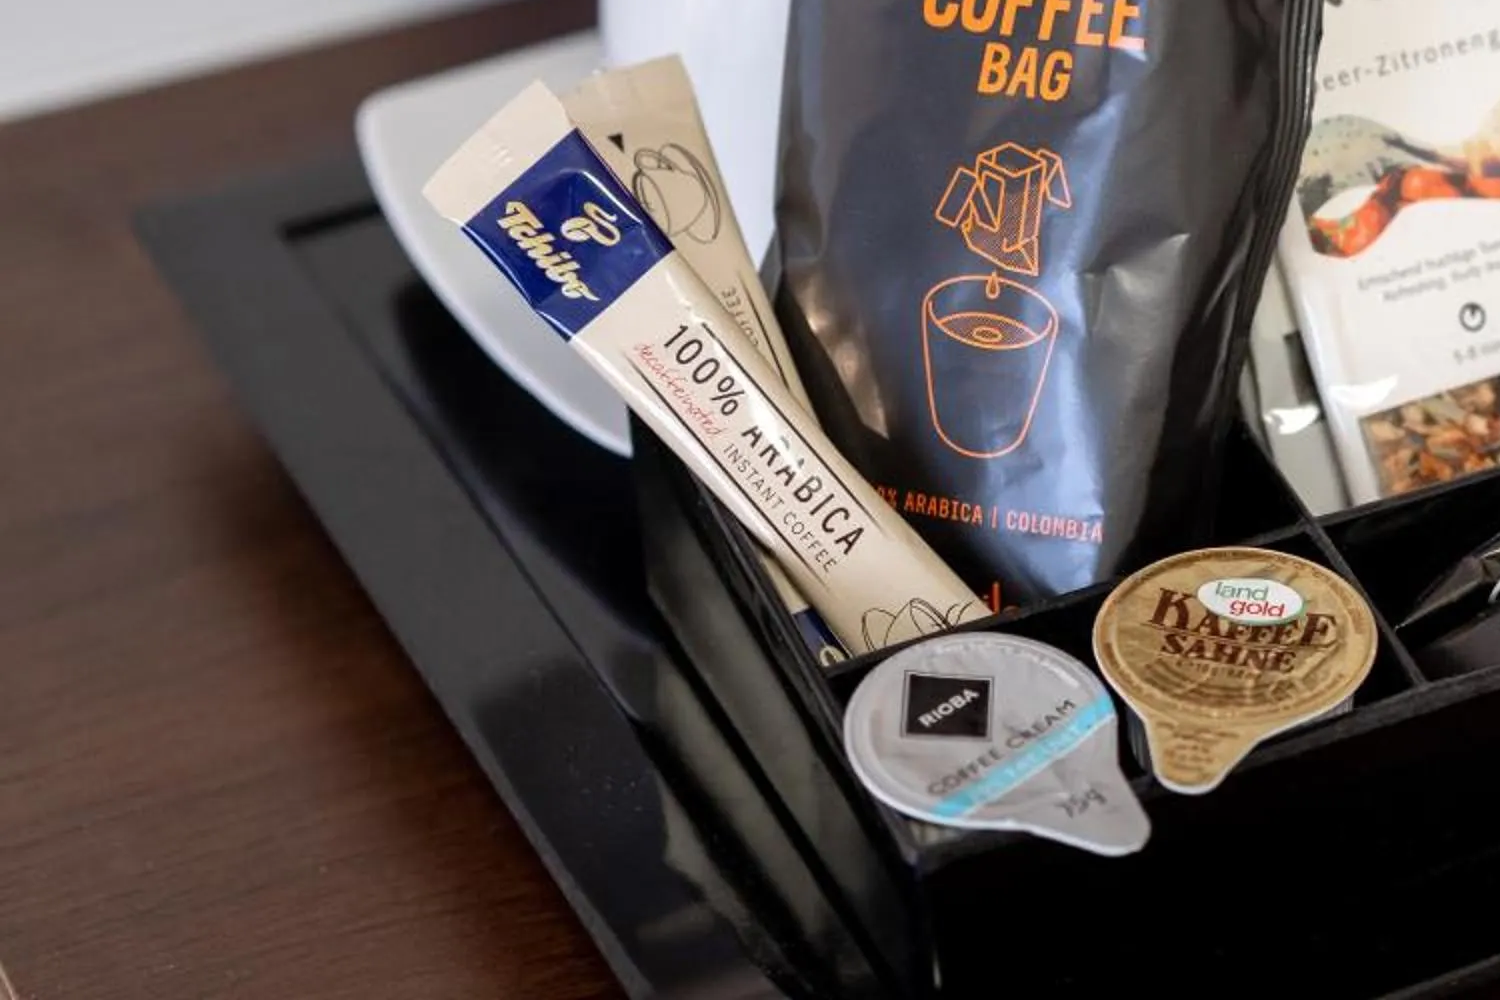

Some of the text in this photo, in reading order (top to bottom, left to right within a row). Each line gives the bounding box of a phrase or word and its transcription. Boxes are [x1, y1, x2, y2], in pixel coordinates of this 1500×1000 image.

[976, 41, 1074, 102] BAG
[496, 201, 600, 300] Tchibo
[663, 324, 865, 555] 100% ARABICA
[723, 443, 838, 573] INSTANT COFFEE
[904, 490, 983, 526] ARABICA
[1005, 509, 1104, 545] COLOMBIA
[1214, 581, 1270, 601] land
[1228, 600, 1286, 618] gold
[1160, 632, 1297, 674] SAHNE
[917, 688, 980, 728] RIOBA
[926, 747, 1003, 797] COFFEE
[1005, 698, 1077, 750] CREAM
